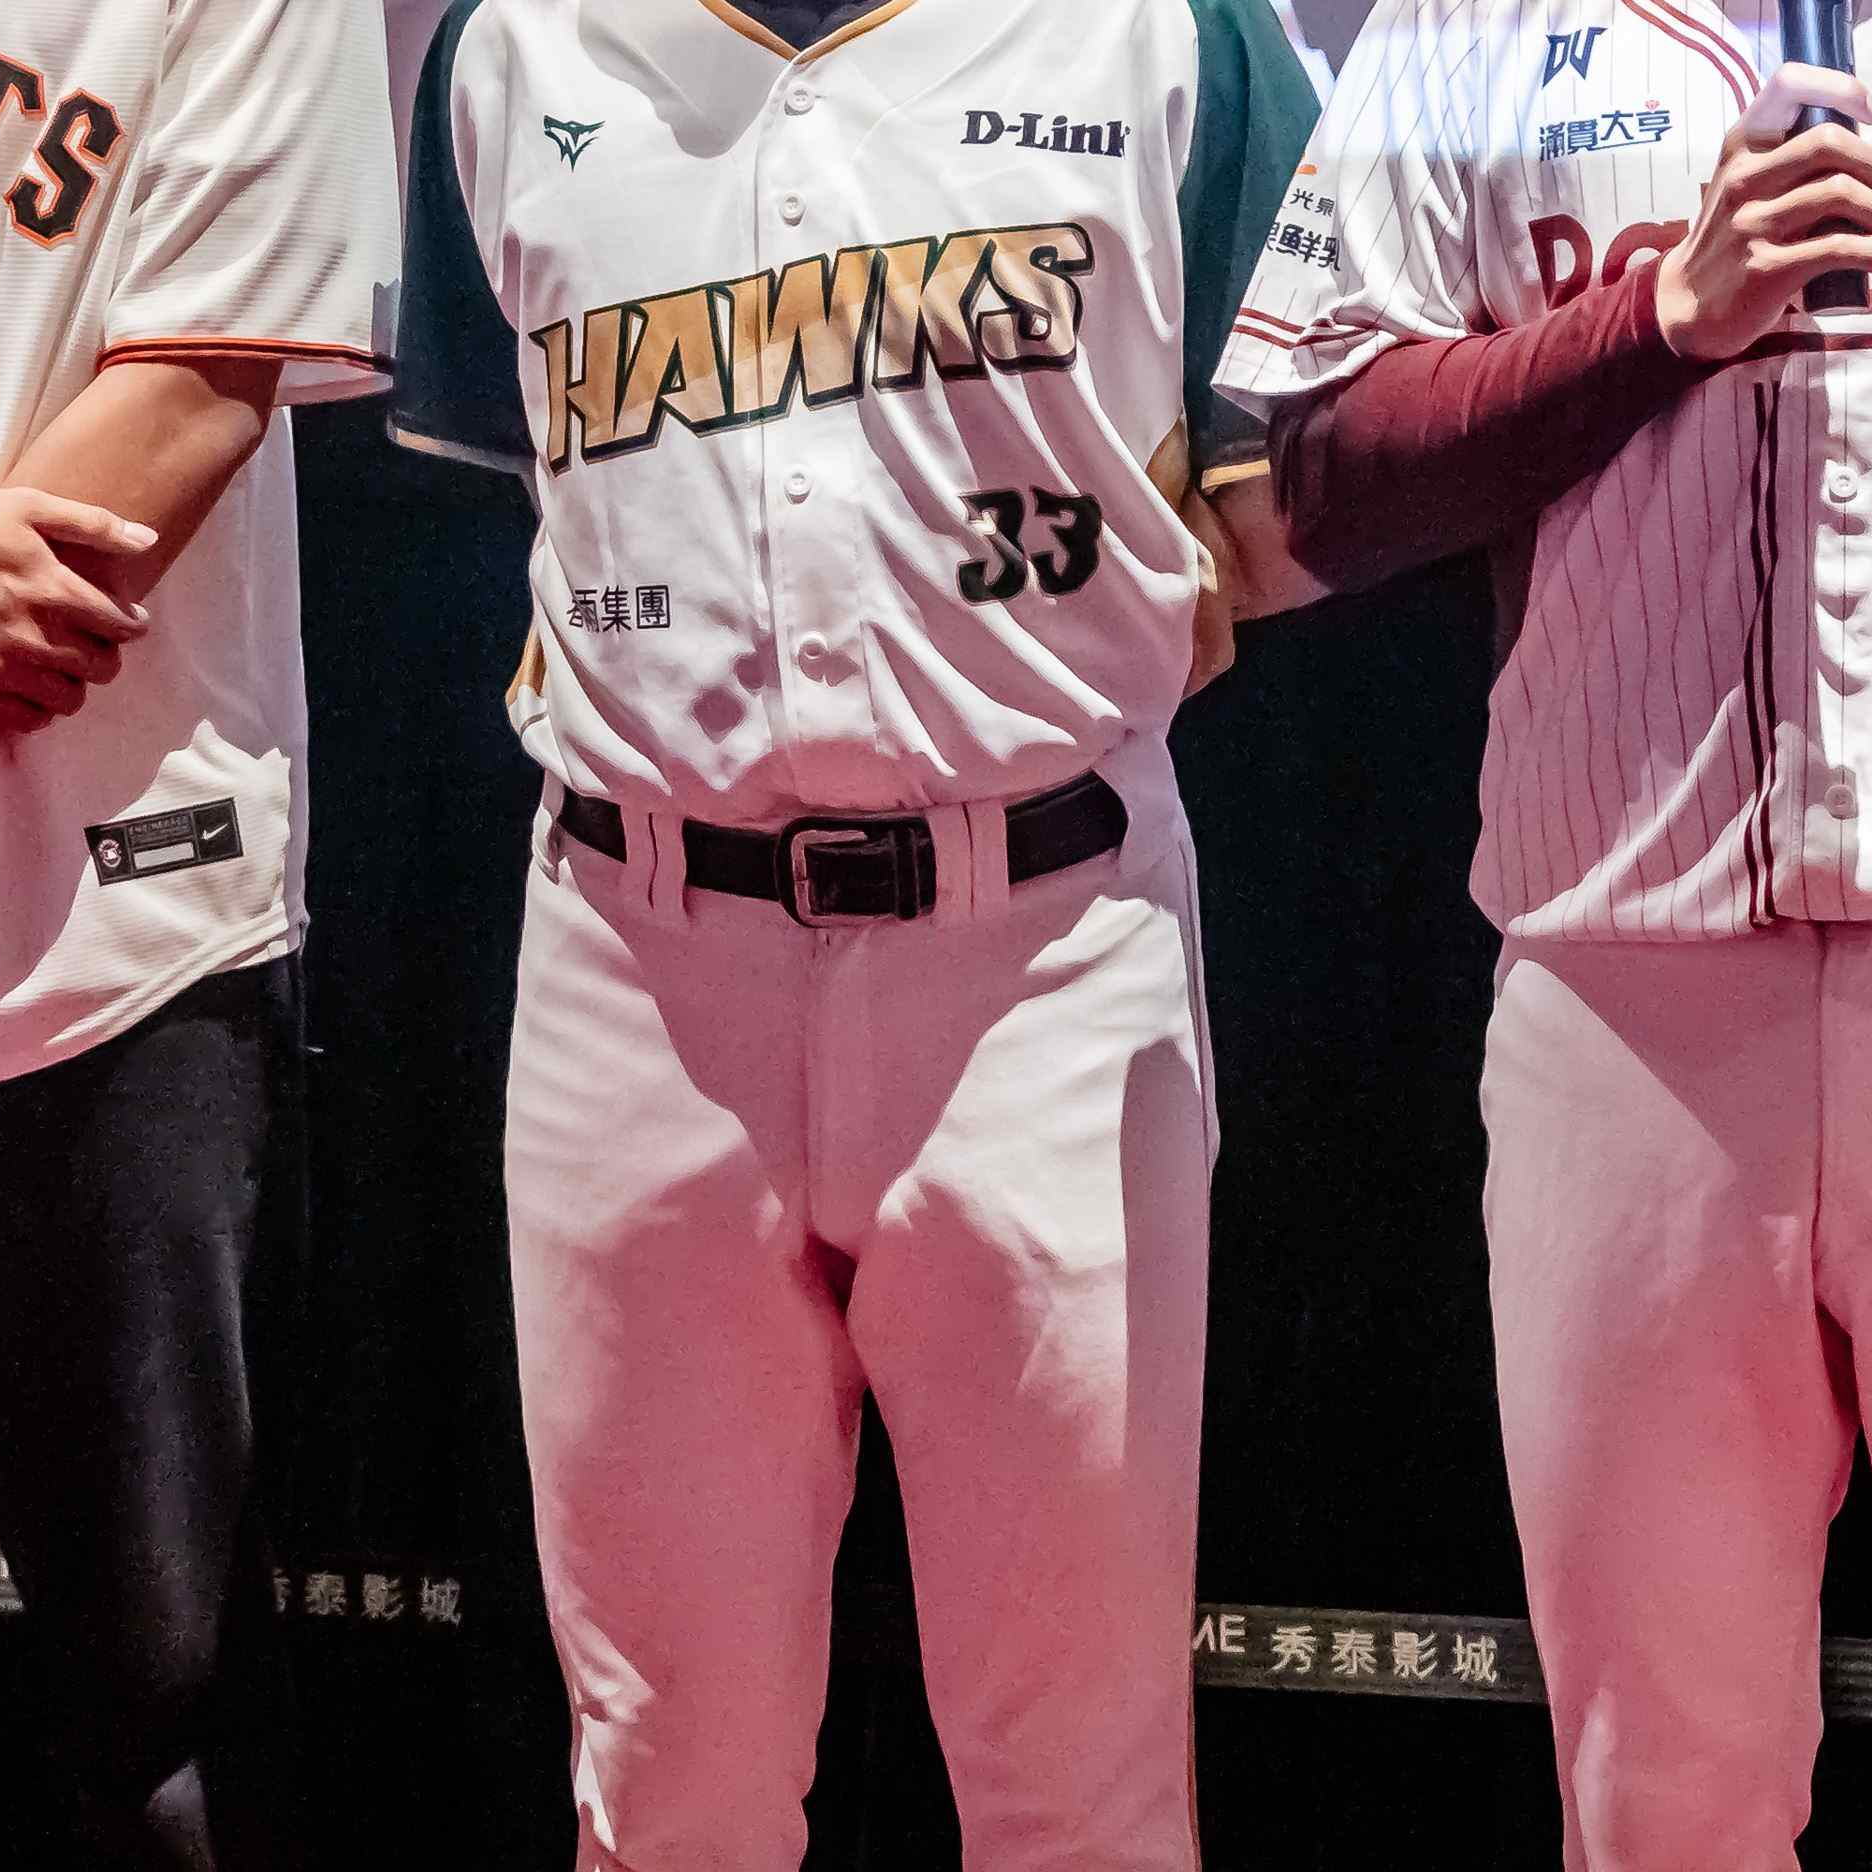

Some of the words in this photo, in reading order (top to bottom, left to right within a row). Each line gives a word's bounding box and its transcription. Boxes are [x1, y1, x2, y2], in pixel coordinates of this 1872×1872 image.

[960, 110, 1131, 161] D-Link
[528, 220, 1095, 478] HAWKS
[955, 485, 1103, 605] 33
[1270, 1625, 1498, 1683] 秀泰影城
